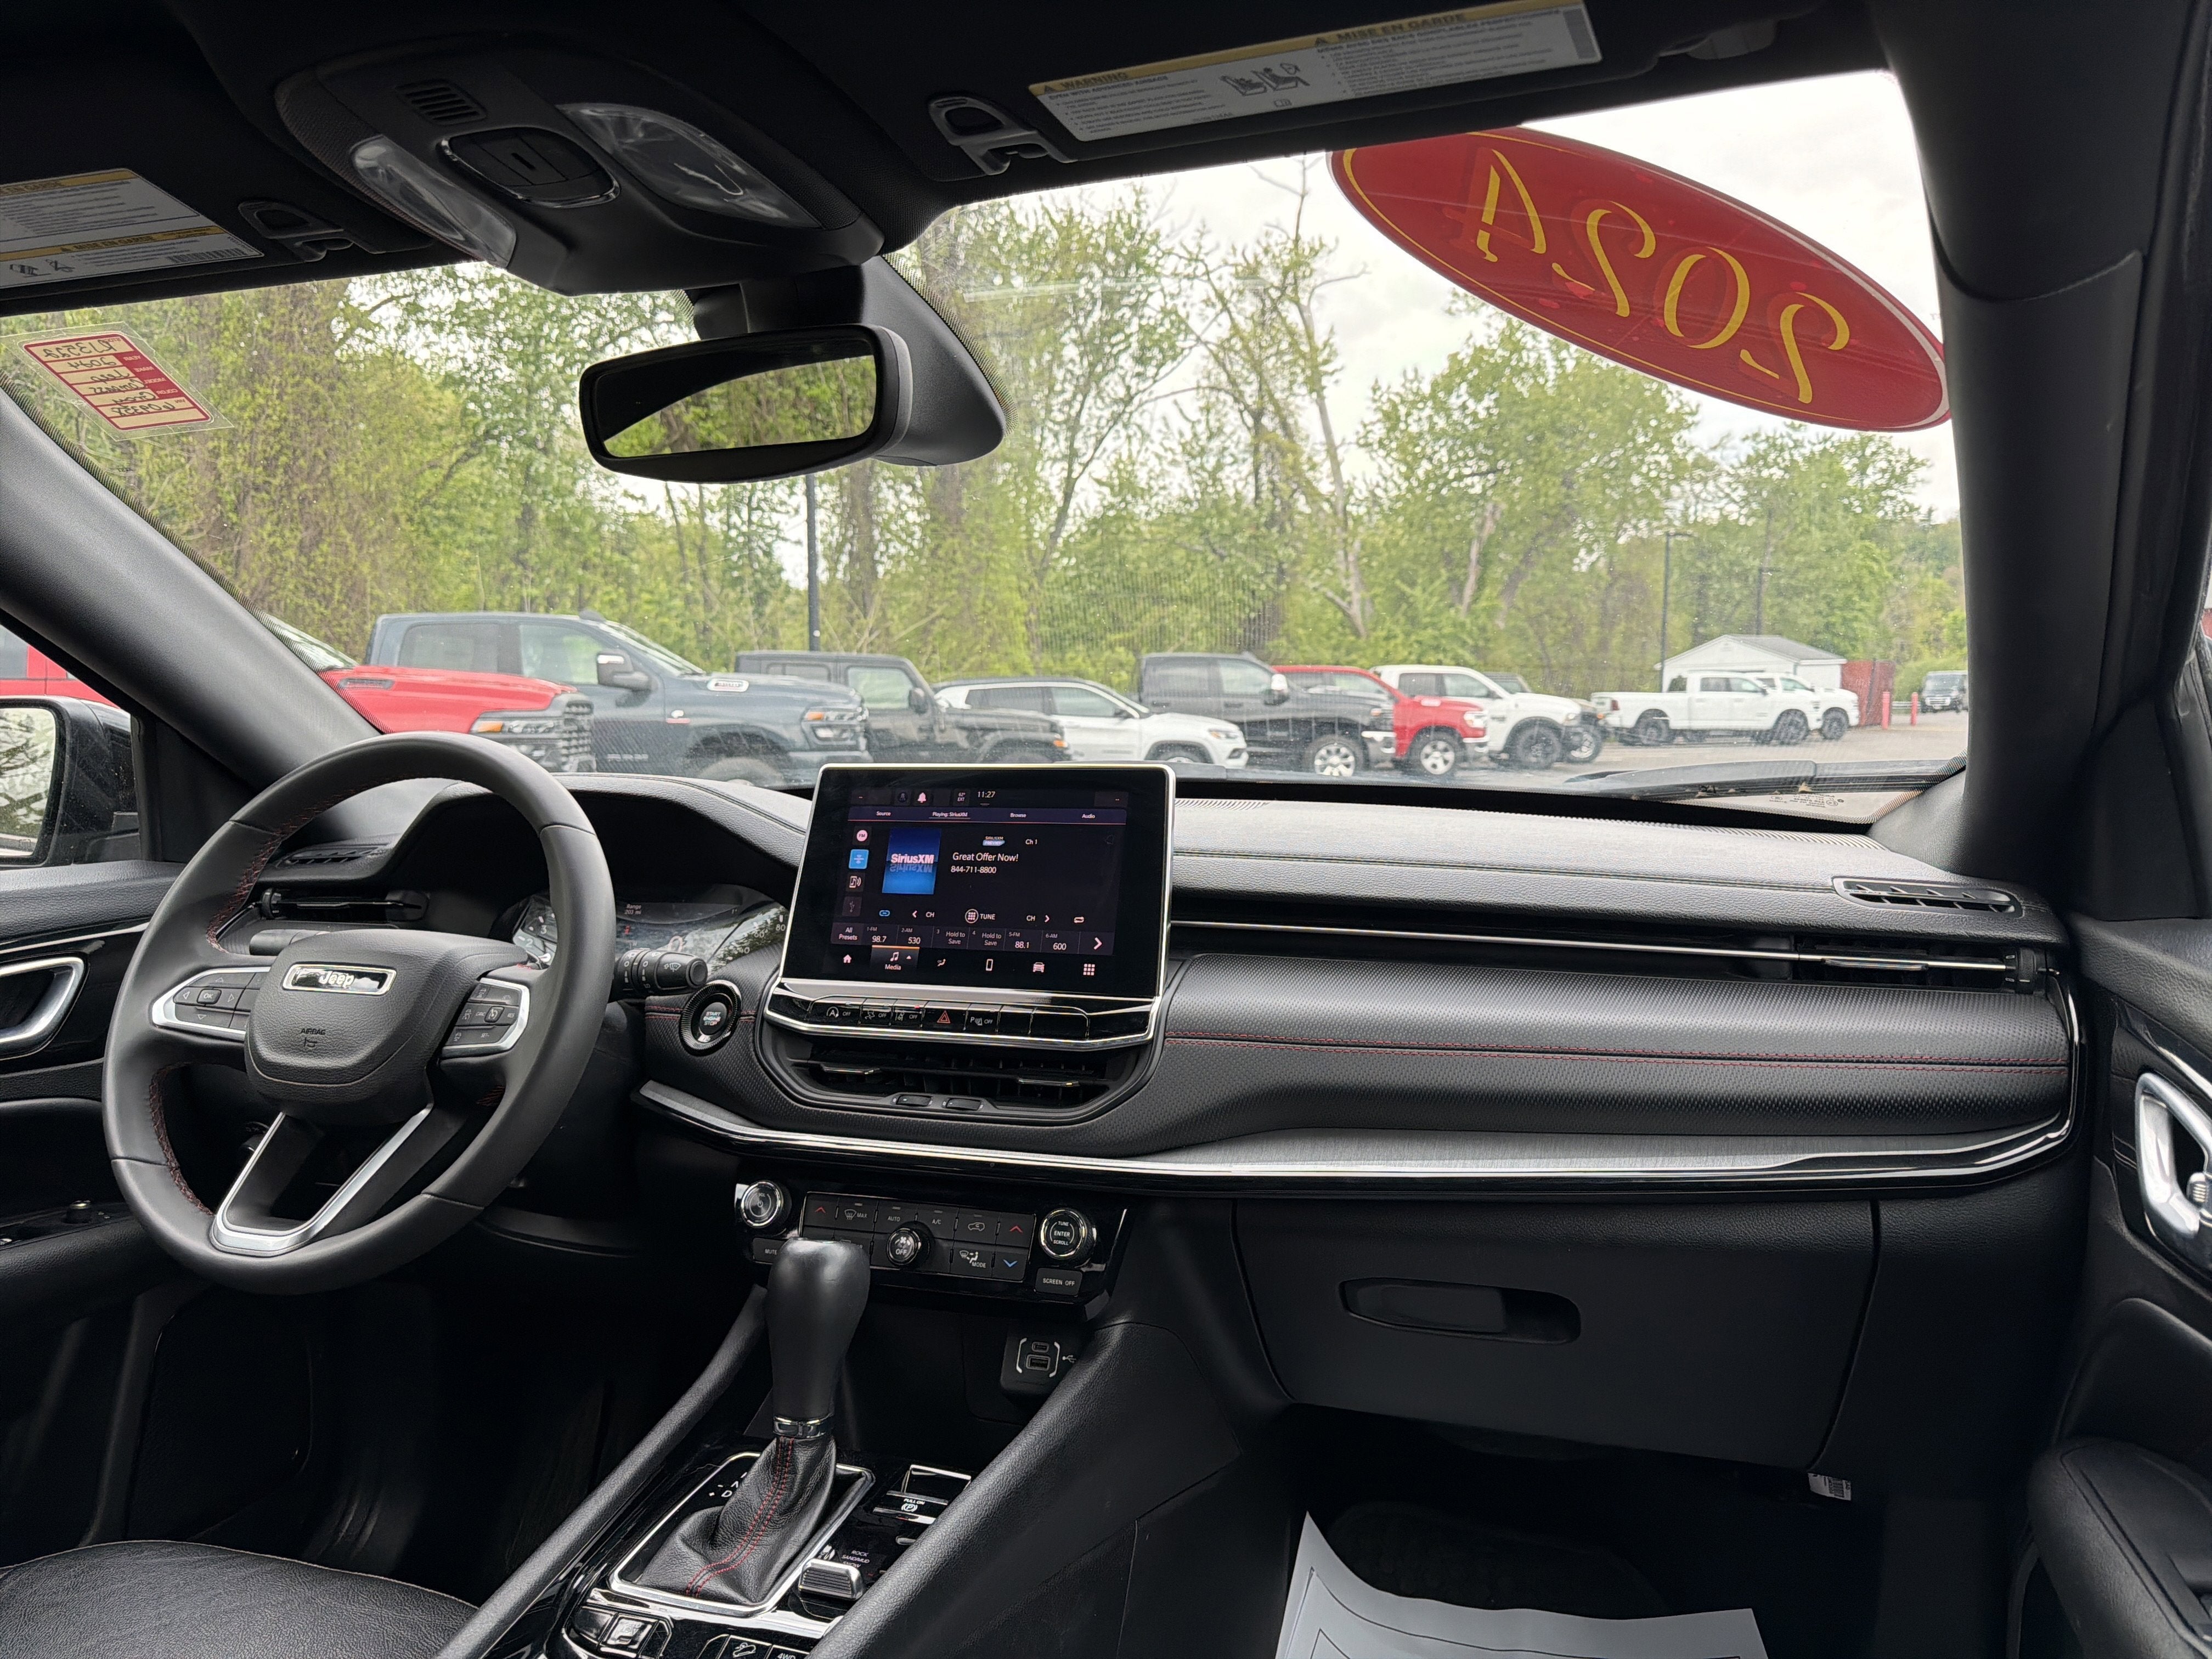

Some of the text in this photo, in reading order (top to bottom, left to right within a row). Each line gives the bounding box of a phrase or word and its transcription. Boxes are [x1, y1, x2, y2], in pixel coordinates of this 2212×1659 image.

[891, 854, 935, 864] SiriusXM
[952, 853, 1018, 862] Great Offer Now!
[540, 924, 547, 935] 3
[525, 938, 533, 947] 2
[319, 970, 354, 989] Jeep
[721, 1489, 733, 1498] D
[842, 1554, 870, 1564] SAND/MUD
